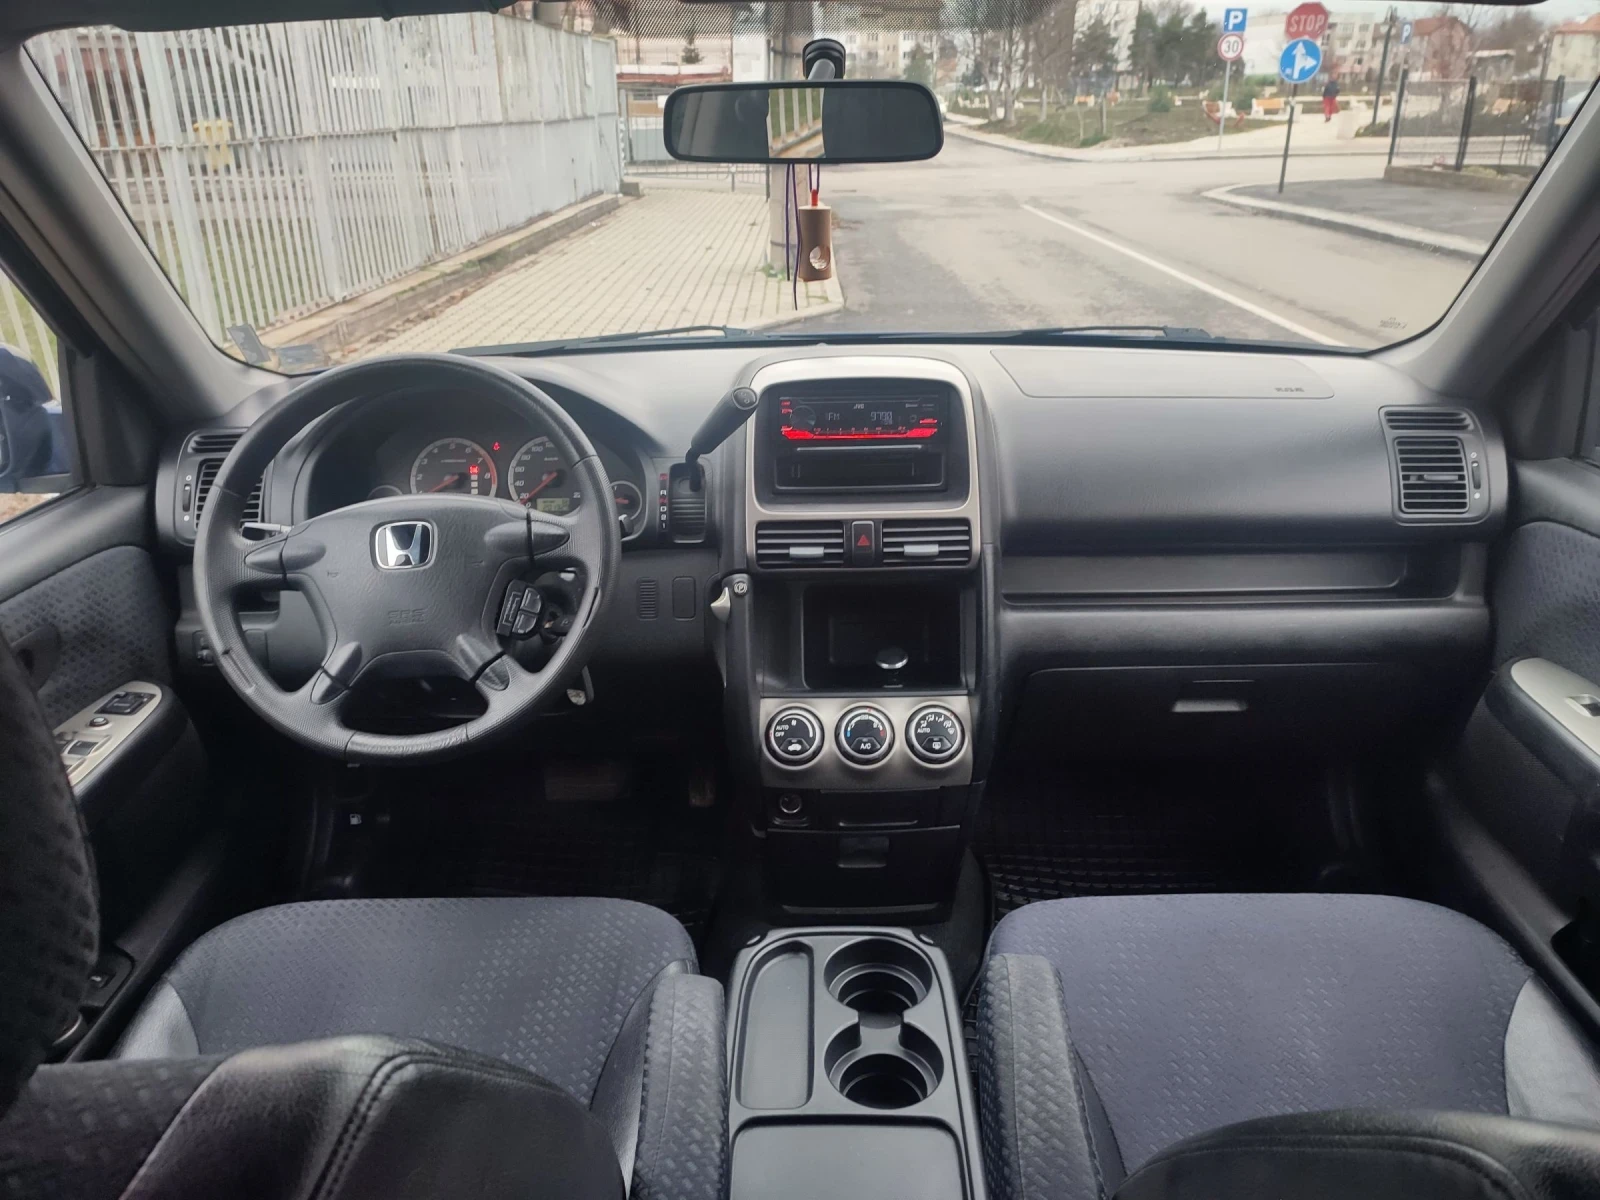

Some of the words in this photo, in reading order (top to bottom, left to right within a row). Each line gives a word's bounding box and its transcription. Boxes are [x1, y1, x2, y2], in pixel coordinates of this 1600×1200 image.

[1227, 10, 1243, 30] P
[1289, 14, 1326, 33] STOP
[1402, 24, 1411, 43] P
[1224, 40, 1239, 54] 30
